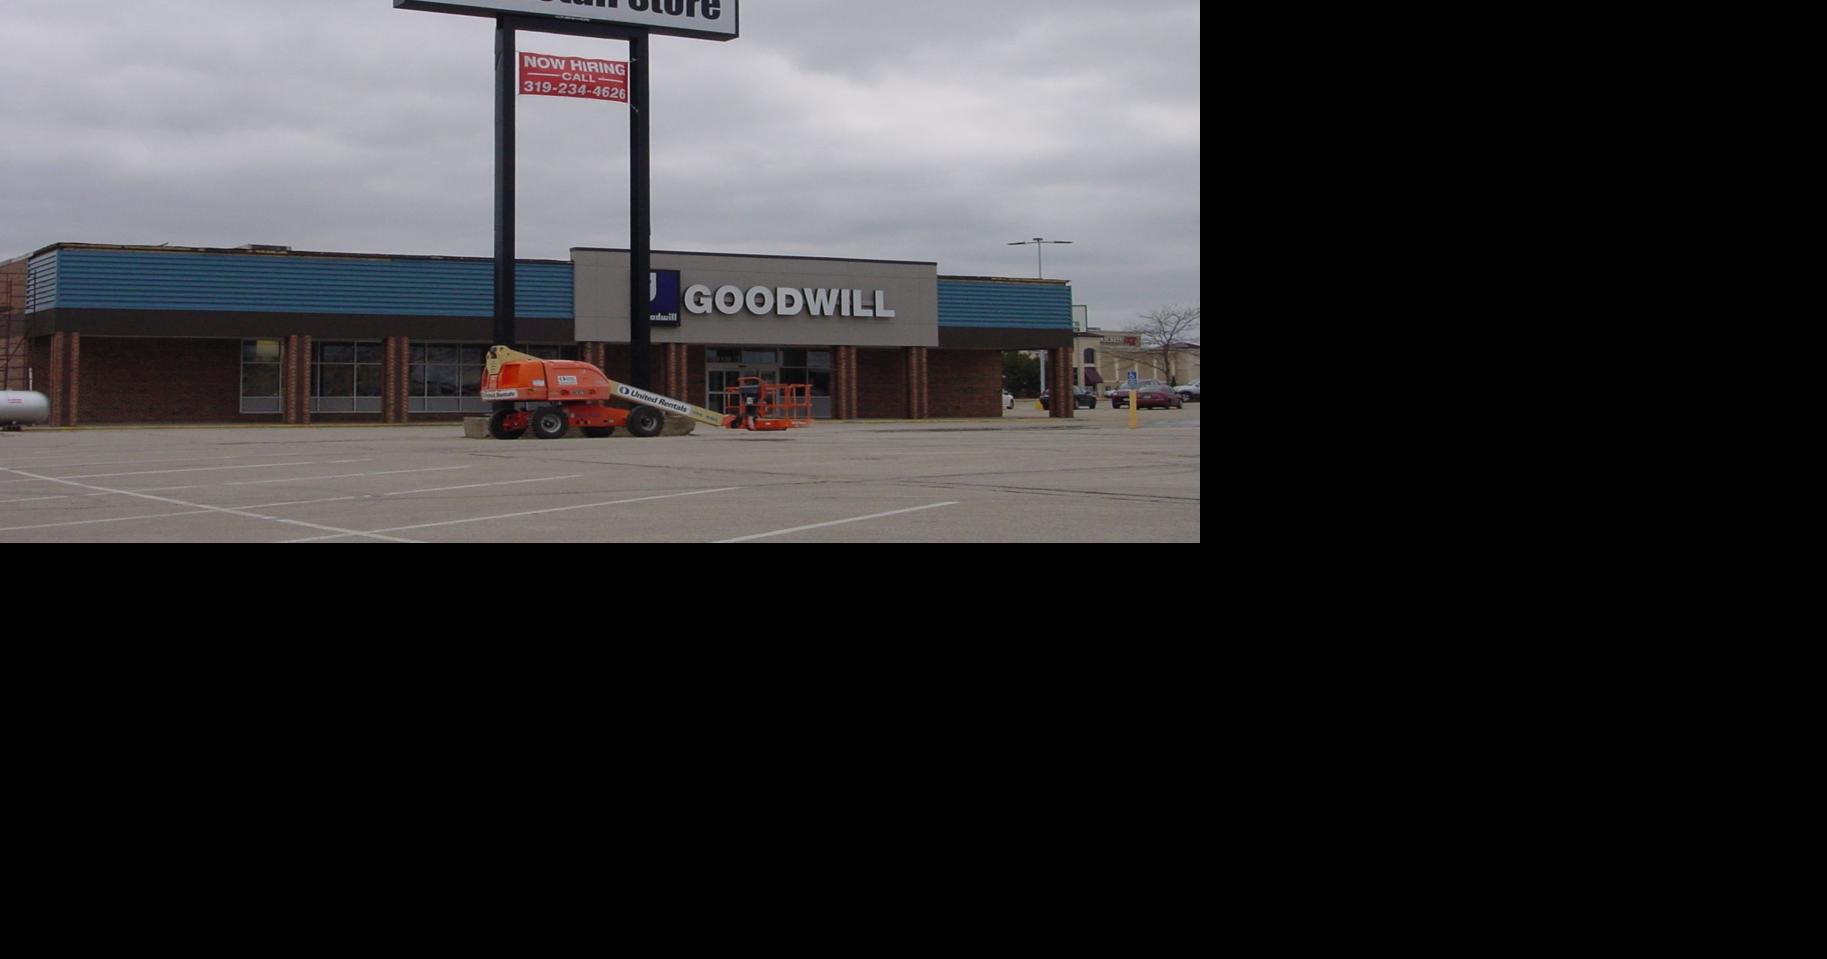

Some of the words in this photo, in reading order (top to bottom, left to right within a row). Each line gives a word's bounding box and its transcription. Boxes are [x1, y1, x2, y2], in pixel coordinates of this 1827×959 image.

[524, 55, 565, 70] NOW
[570, 59, 626, 76] HIRING
[561, 72, 597, 83] CALL
[523, 80, 626, 99] 319-234-4626
[684, 284, 896, 318] GOODWILL
[650, 312, 677, 321] odwill
[630, 389, 658, 404] United
[658, 398, 688, 413] Rentals
